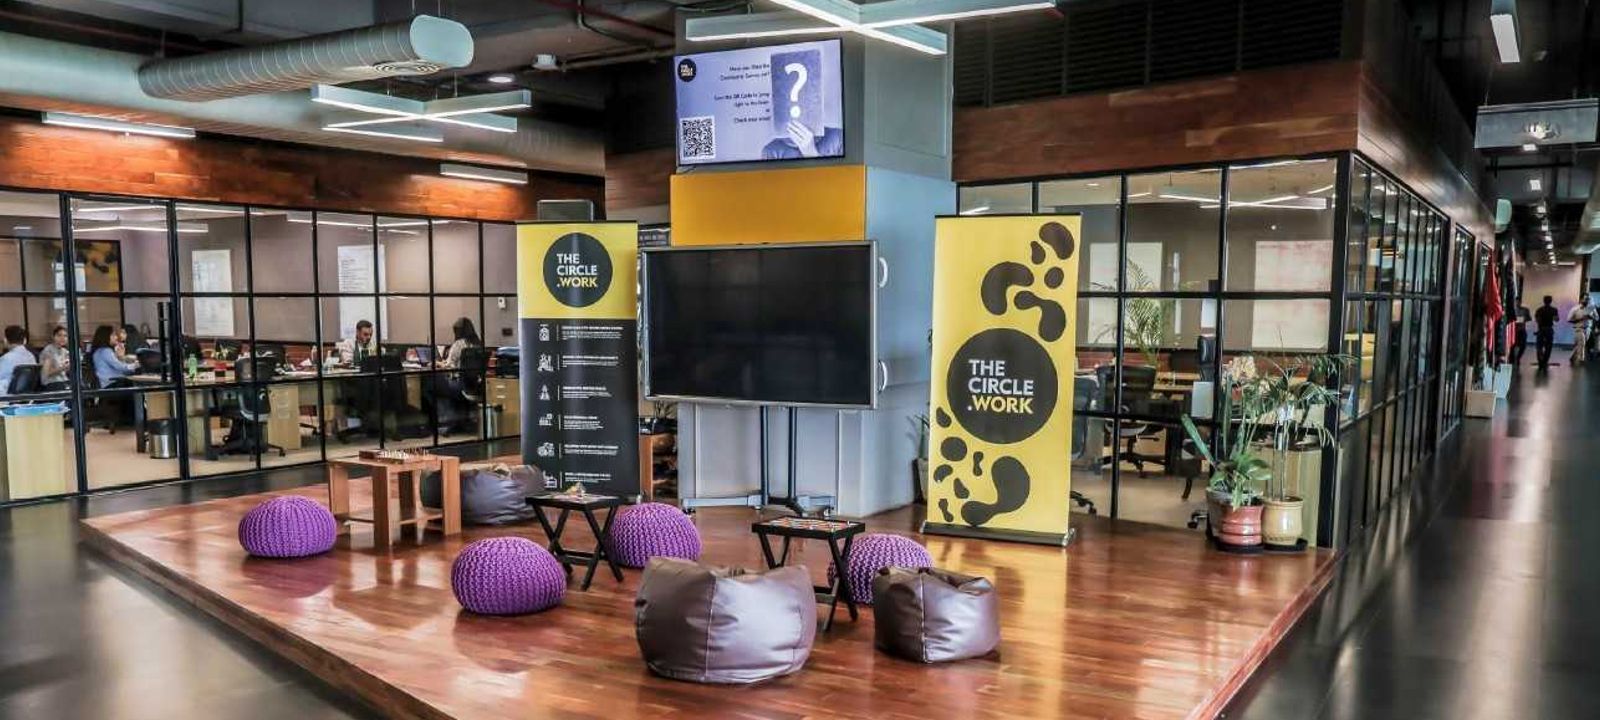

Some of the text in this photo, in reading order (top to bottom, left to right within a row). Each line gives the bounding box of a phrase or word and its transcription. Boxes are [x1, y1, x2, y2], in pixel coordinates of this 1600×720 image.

[556, 253, 580, 264] THE
[556, 265, 598, 276] CIRCLE
[556, 276, 598, 288] .WORK
[968, 359, 1006, 376] THE
[968, 377, 1034, 396] CIRCLE
[967, 394, 1034, 415] .WORK
